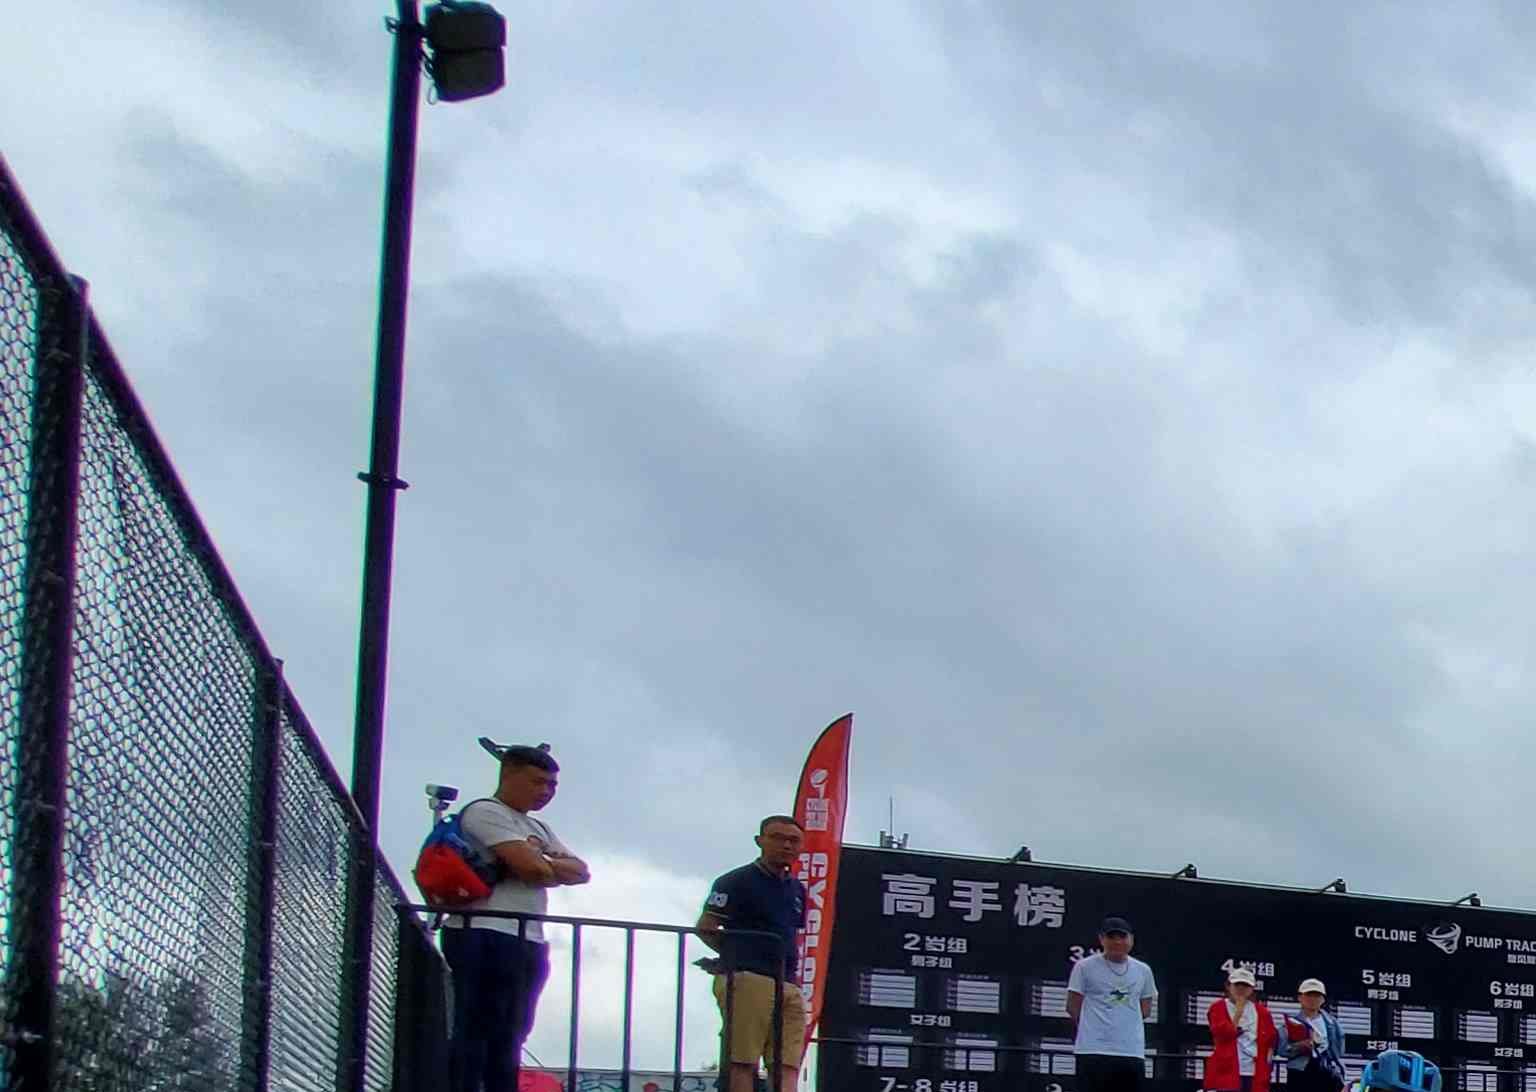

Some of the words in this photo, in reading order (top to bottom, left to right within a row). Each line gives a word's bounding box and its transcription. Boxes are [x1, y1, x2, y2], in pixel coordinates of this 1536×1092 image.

[881, 873, 1066, 928] 高手榜
[1355, 926, 1417, 943] CYCLONE
[1465, 936, 1503, 949] PUMP
